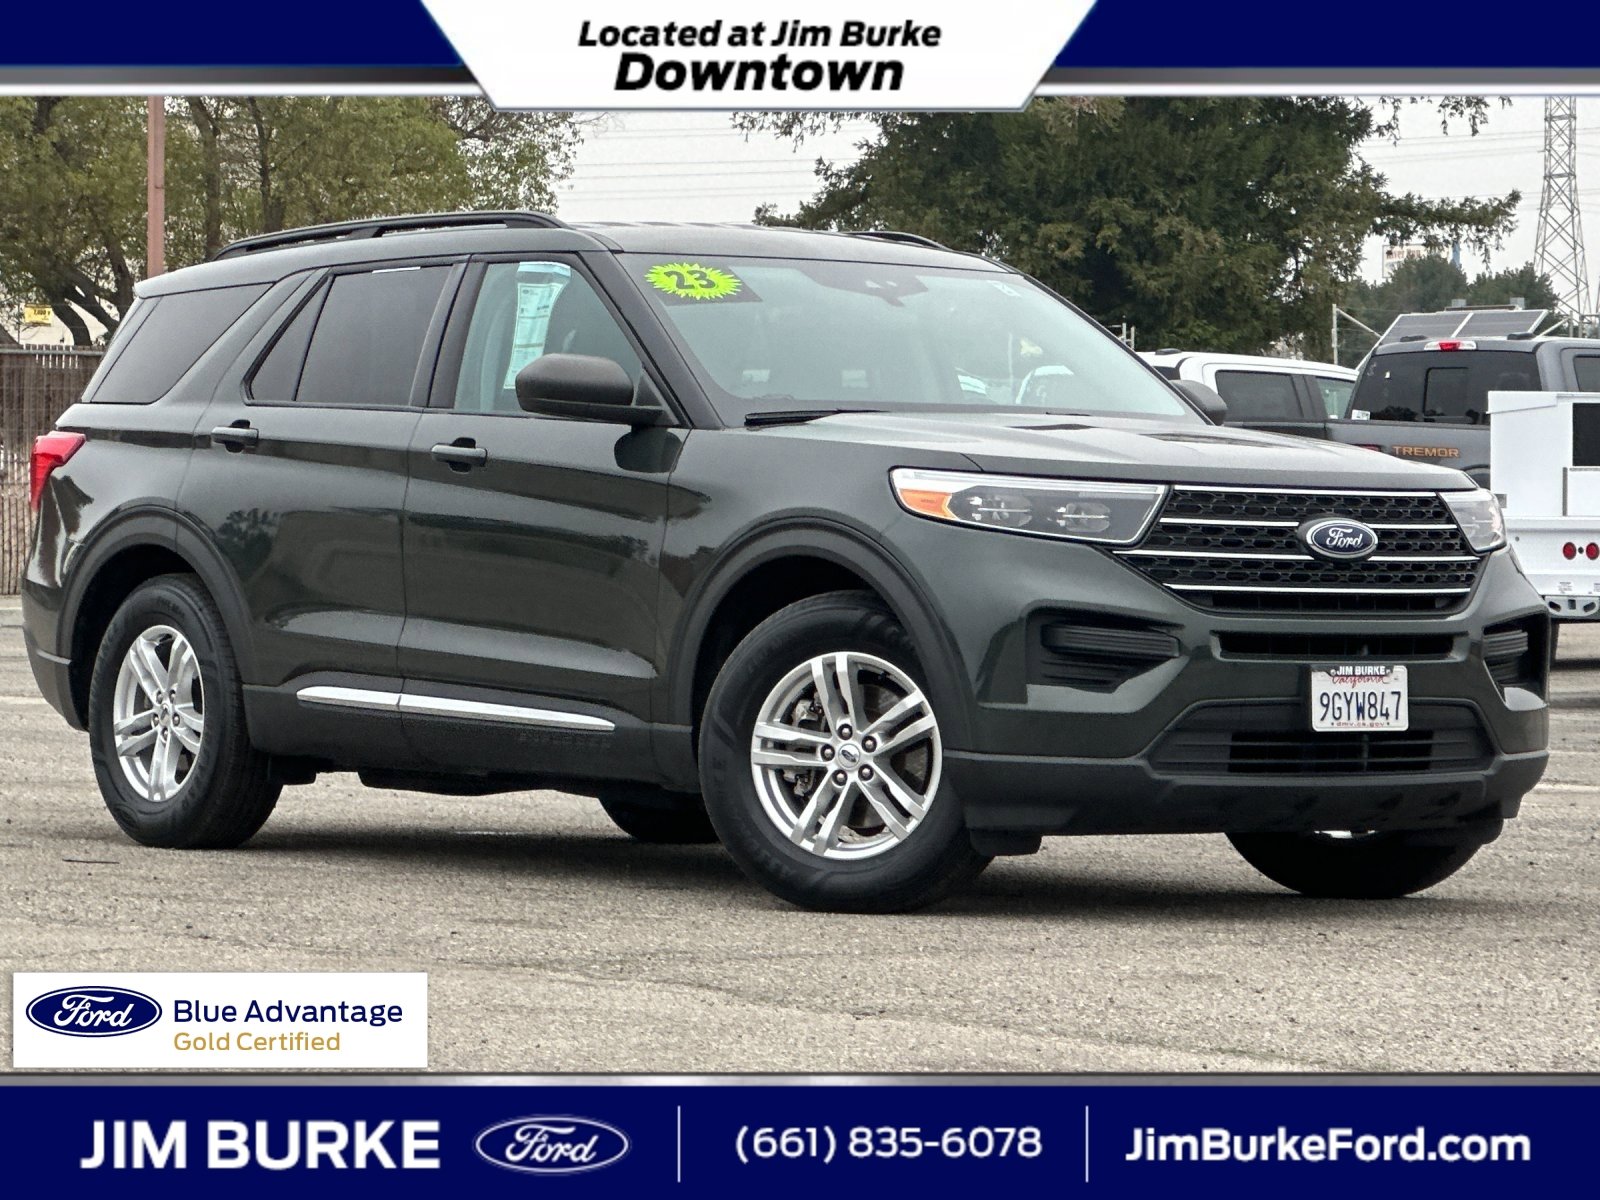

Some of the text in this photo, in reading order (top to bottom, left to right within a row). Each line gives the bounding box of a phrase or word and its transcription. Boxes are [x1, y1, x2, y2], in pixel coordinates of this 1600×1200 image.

[664, 270, 716, 289] 23
[1392, 446, 1460, 458] TREMOR
[1326, 527, 1363, 548] Ford
[1336, 665, 1386, 675] JIM BURKE
[1320, 691, 1401, 721] 9GYW847
